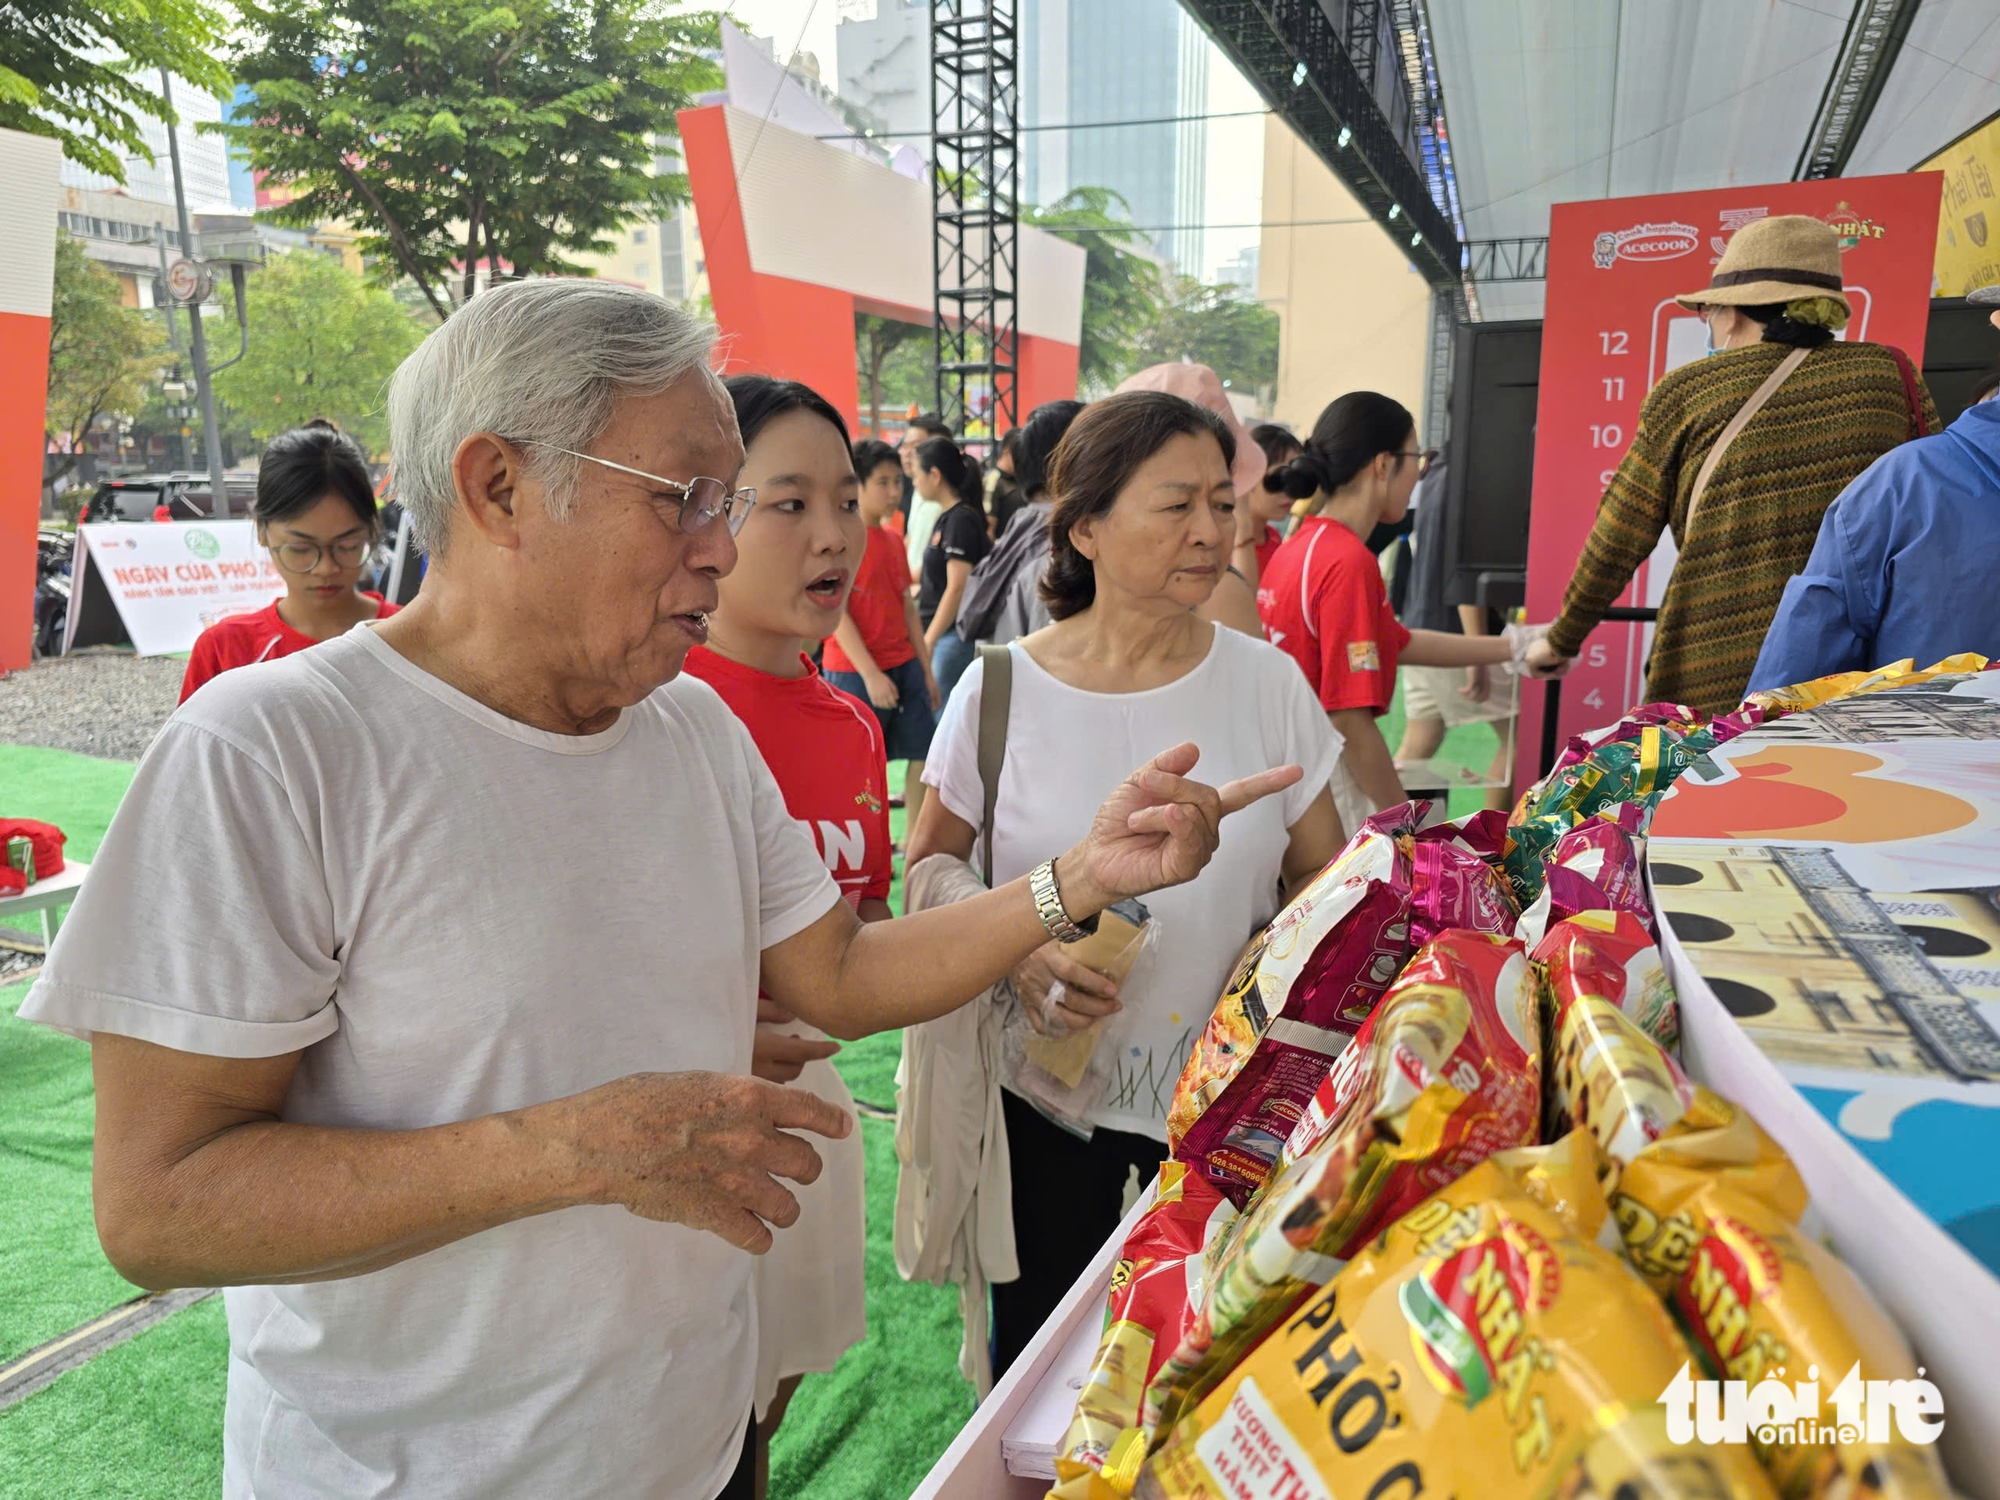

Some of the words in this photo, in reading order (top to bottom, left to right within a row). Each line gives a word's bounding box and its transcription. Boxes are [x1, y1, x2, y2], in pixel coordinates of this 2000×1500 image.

[1599, 331, 1629, 355] 12
[1602, 377, 1625, 401] 11
[1589, 423, 1623, 448] 10
[1588, 645, 1607, 668] 5
[1583, 687, 1604, 710] 4
[1286, 1287, 1402, 1454] PHỞ
